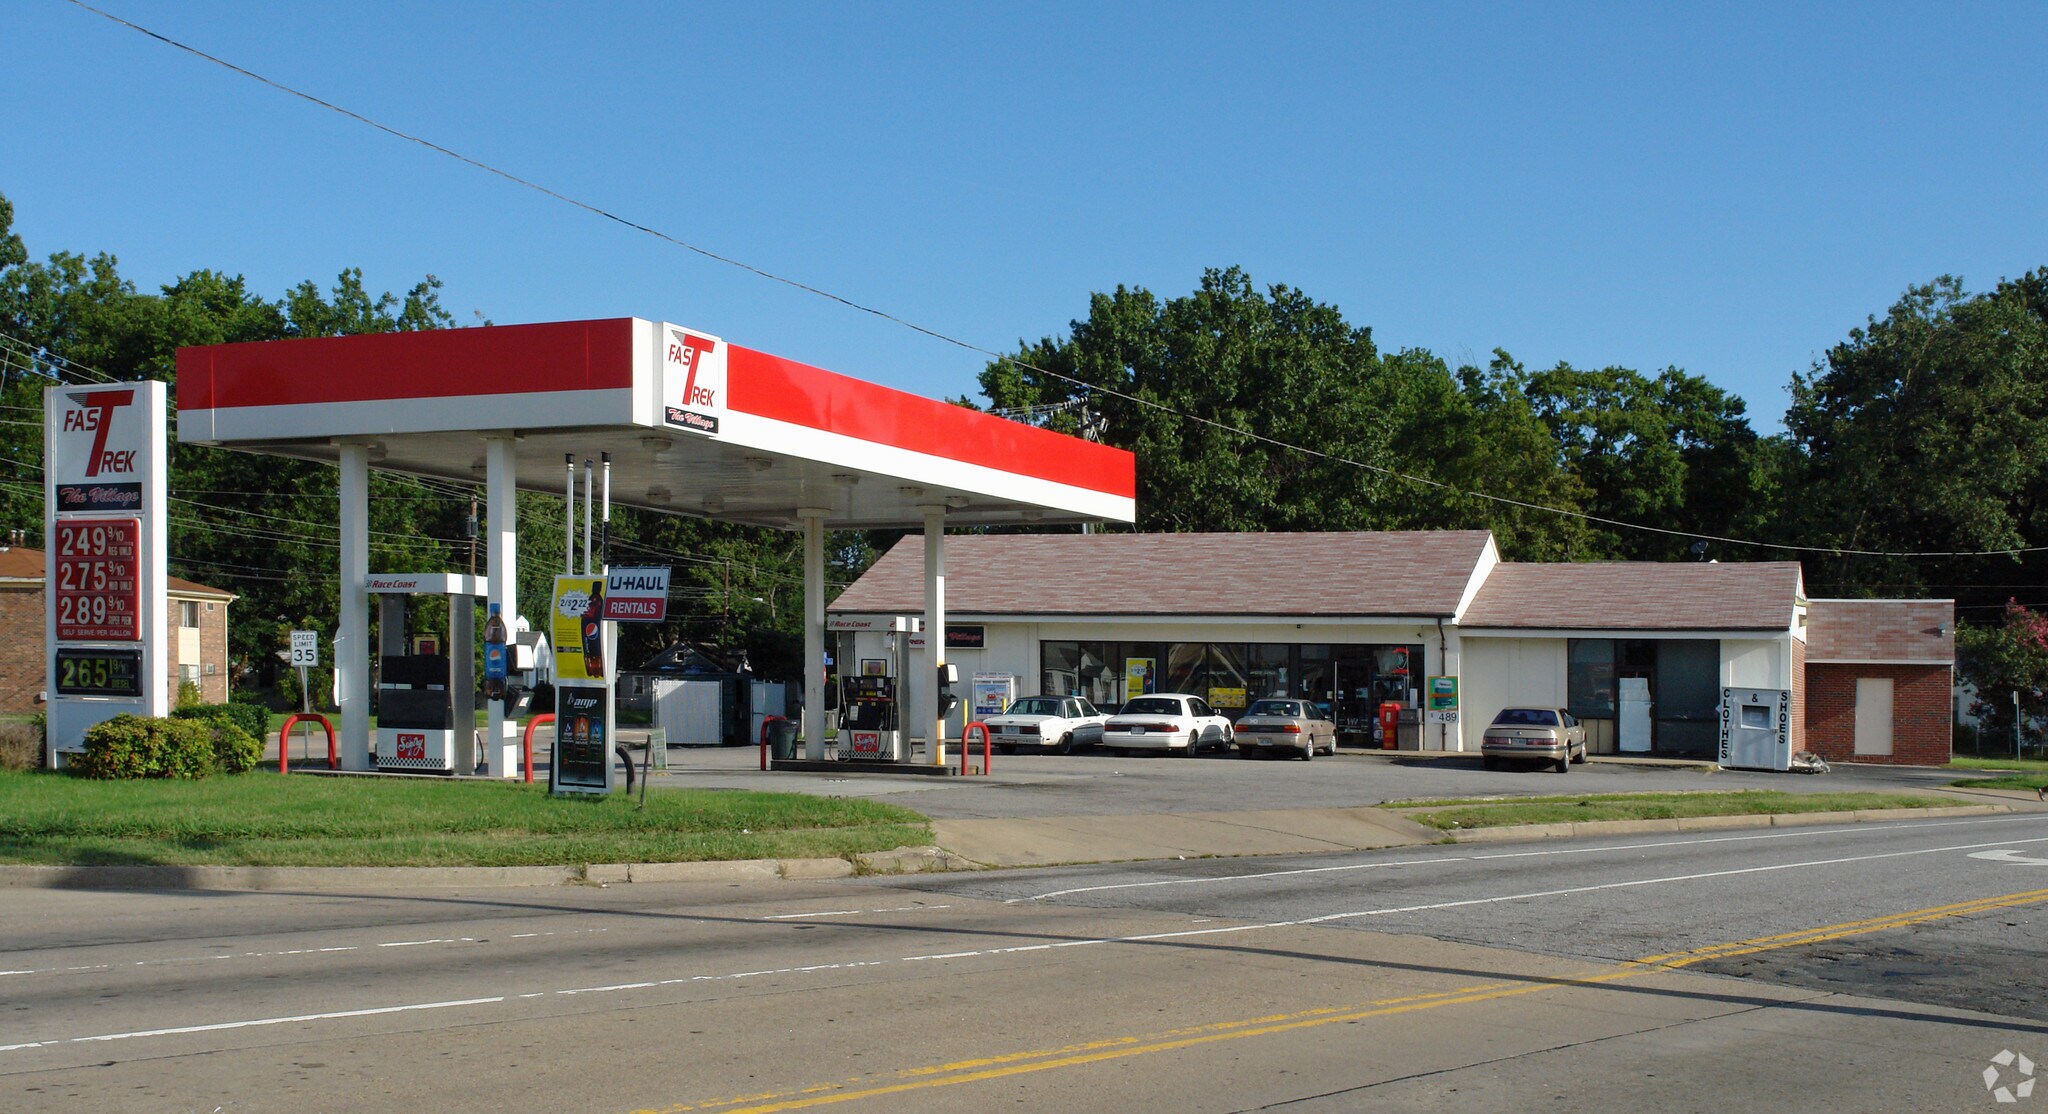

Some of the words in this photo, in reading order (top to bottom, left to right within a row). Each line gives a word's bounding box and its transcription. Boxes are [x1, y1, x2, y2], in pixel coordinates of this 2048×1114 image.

[669, 408, 684, 422] The
[685, 412, 714, 429] Village
[60, 487, 87, 504] The
[88, 486, 139, 507] Village
[61, 527, 106, 556] 249
[60, 561, 106, 590] 275
[372, 580, 392, 588] Race
[393, 580, 416, 588] Coast
[610, 576, 665, 590] U-HAUL
[60, 596, 106, 625] 289
[610, 602, 657, 615] RENTALS
[294, 649, 315, 662] 35
[62, 658, 107, 687] 265
[1438, 712, 1457, 722] 489
[1721, 688, 1731, 759] CLOTHES
[1751, 693, 1759, 703] &
[1778, 691, 1788, 744] SHOES
